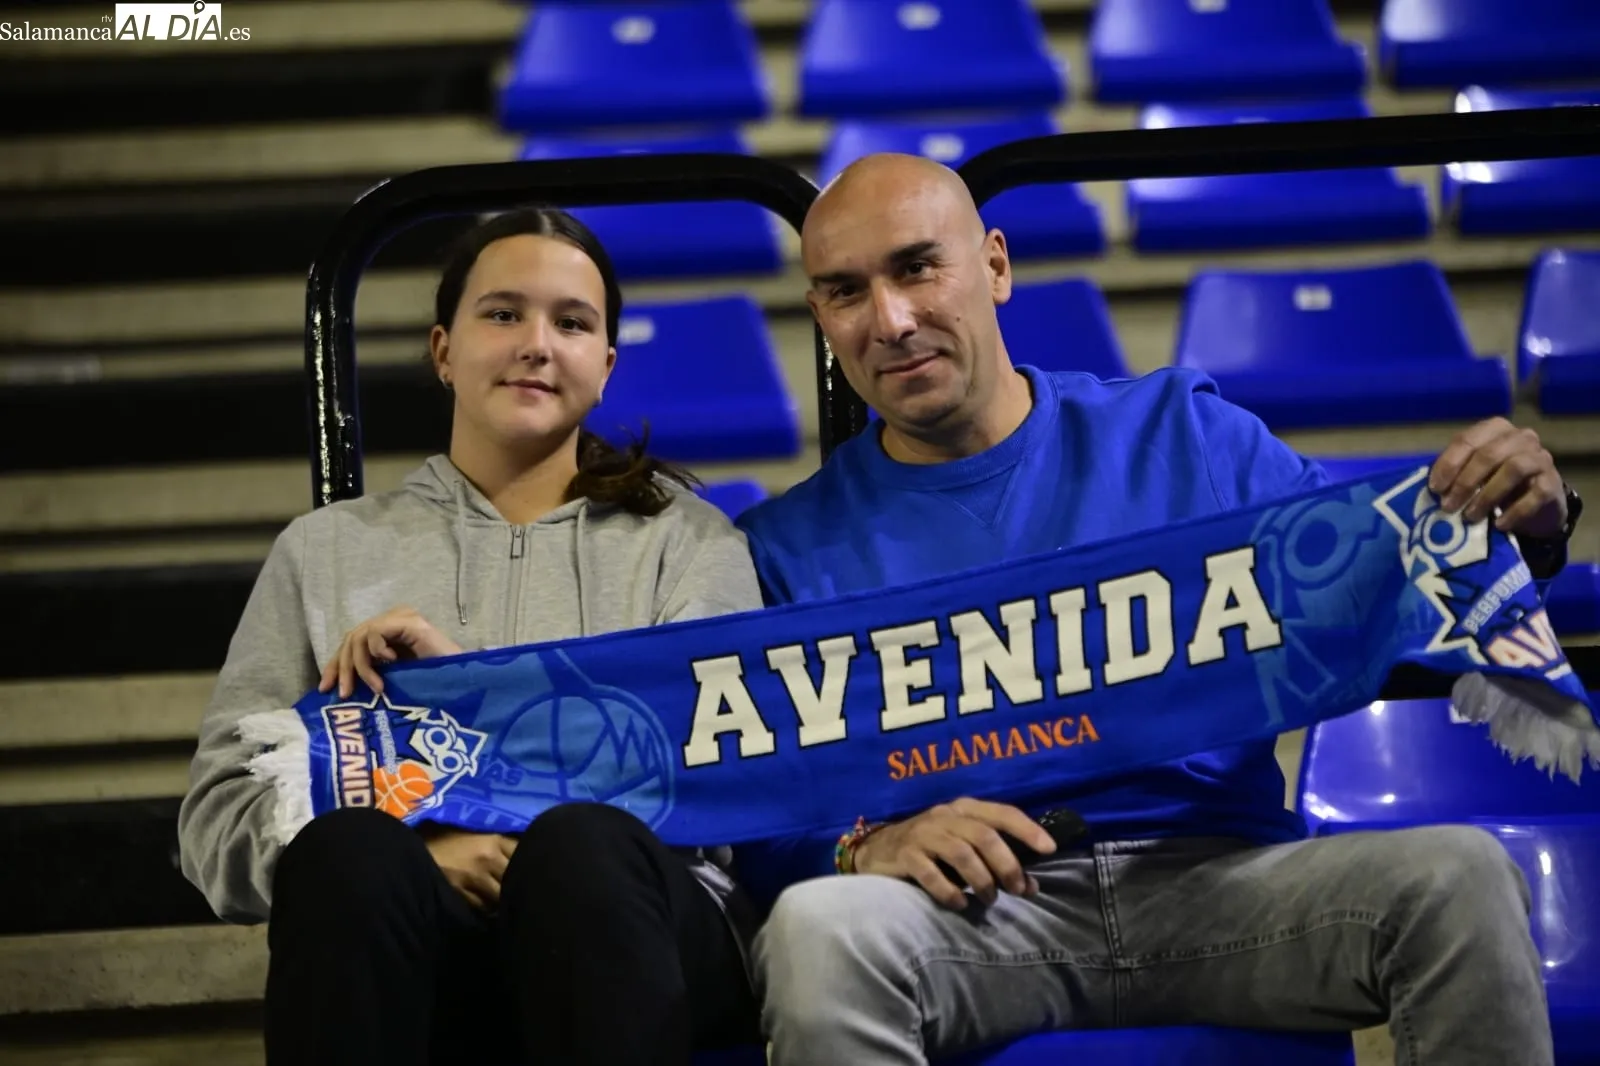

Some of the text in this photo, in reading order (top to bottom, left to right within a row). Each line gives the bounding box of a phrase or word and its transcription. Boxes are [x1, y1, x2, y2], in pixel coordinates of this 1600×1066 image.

[683, 546, 1283, 768] AVENIDA
[331, 708, 371, 808] AVENID
[887, 713, 1100, 781] SALAMANCA
